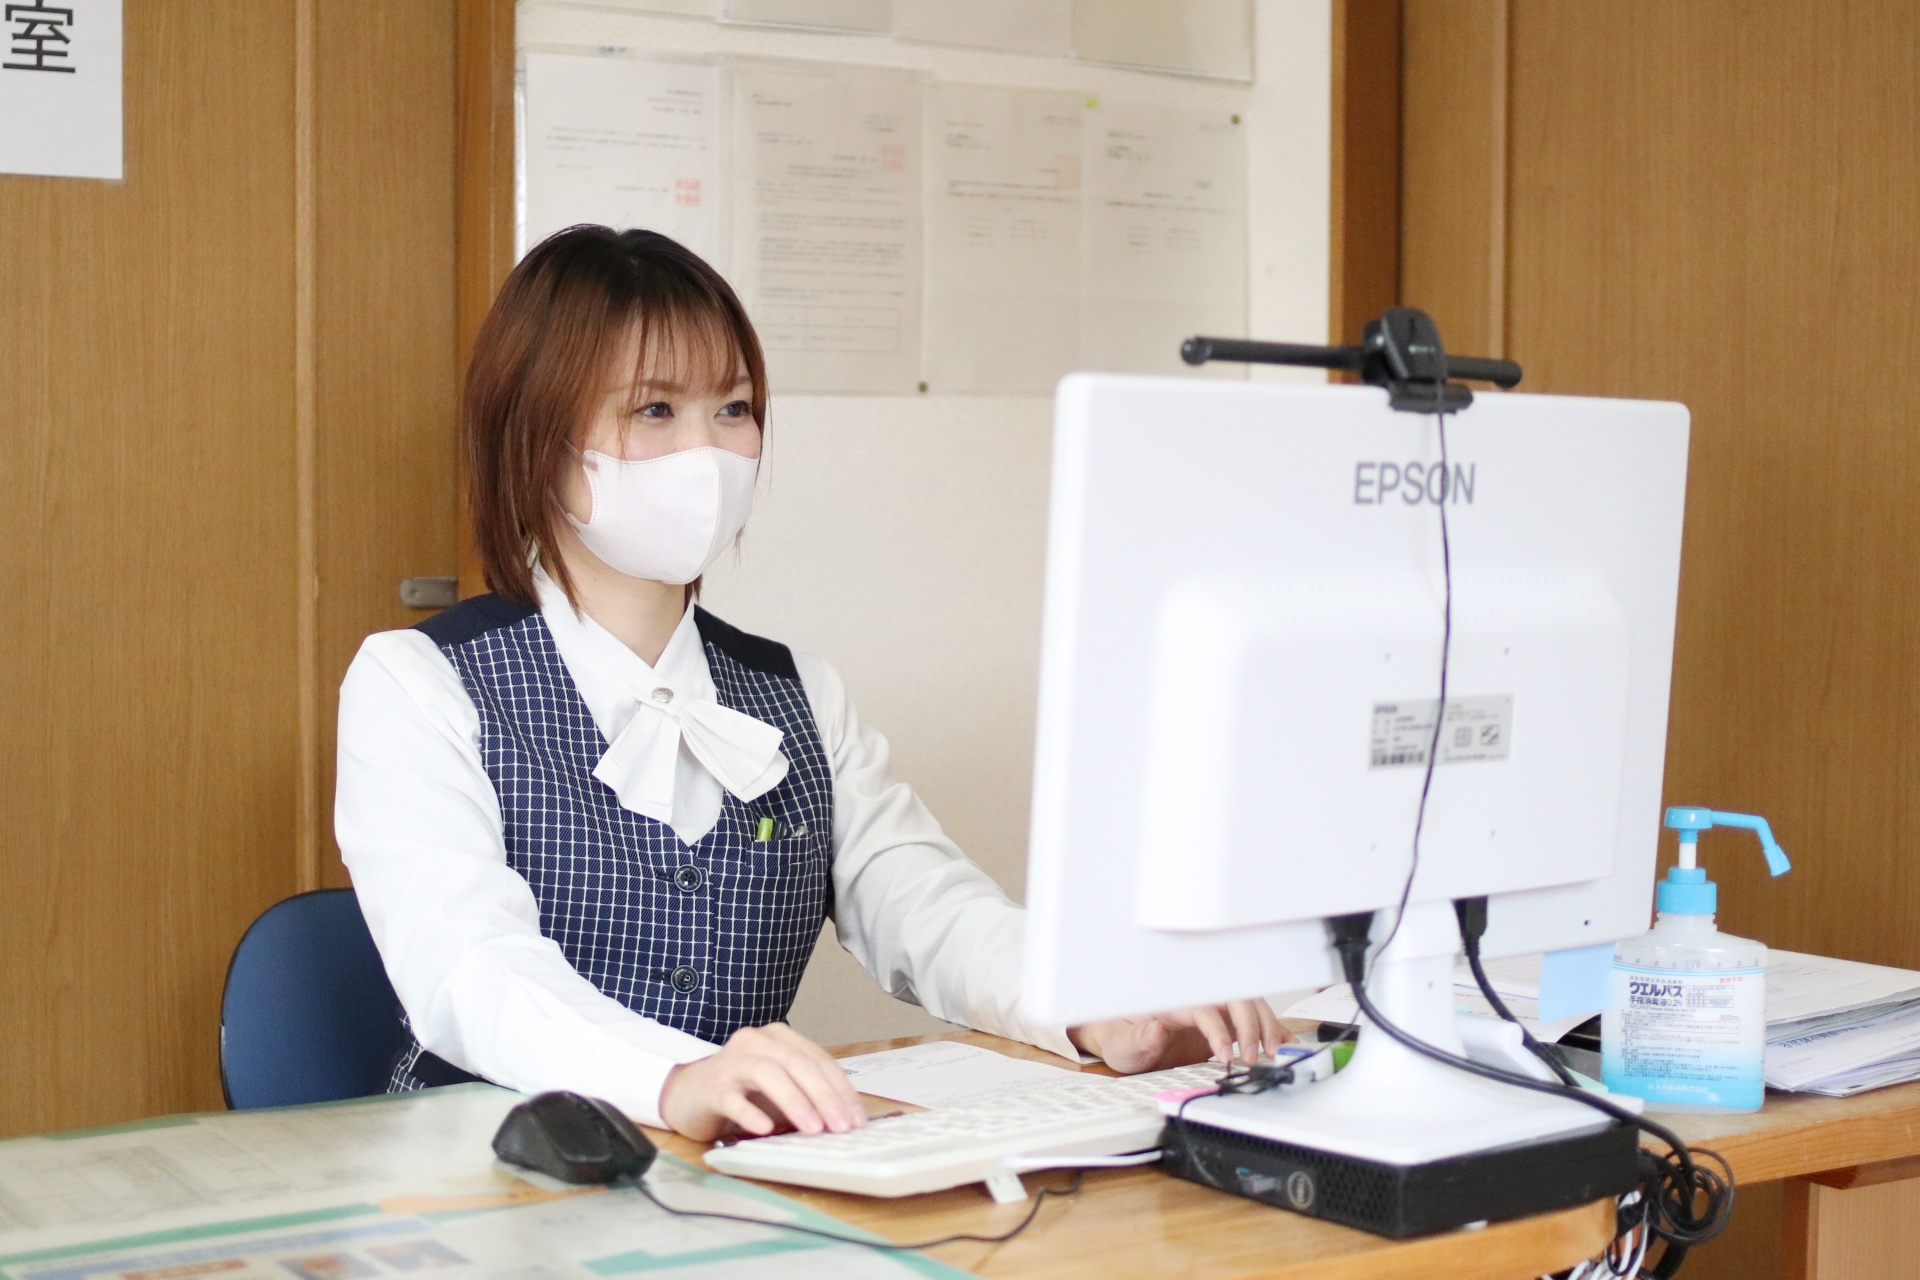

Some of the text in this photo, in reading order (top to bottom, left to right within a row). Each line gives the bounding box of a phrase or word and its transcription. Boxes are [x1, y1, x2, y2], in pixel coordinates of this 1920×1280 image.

[2, 0, 76, 73] 室
[1354, 461, 1476, 505] EPSON
[1629, 981, 1683, 998] ウエルパス
